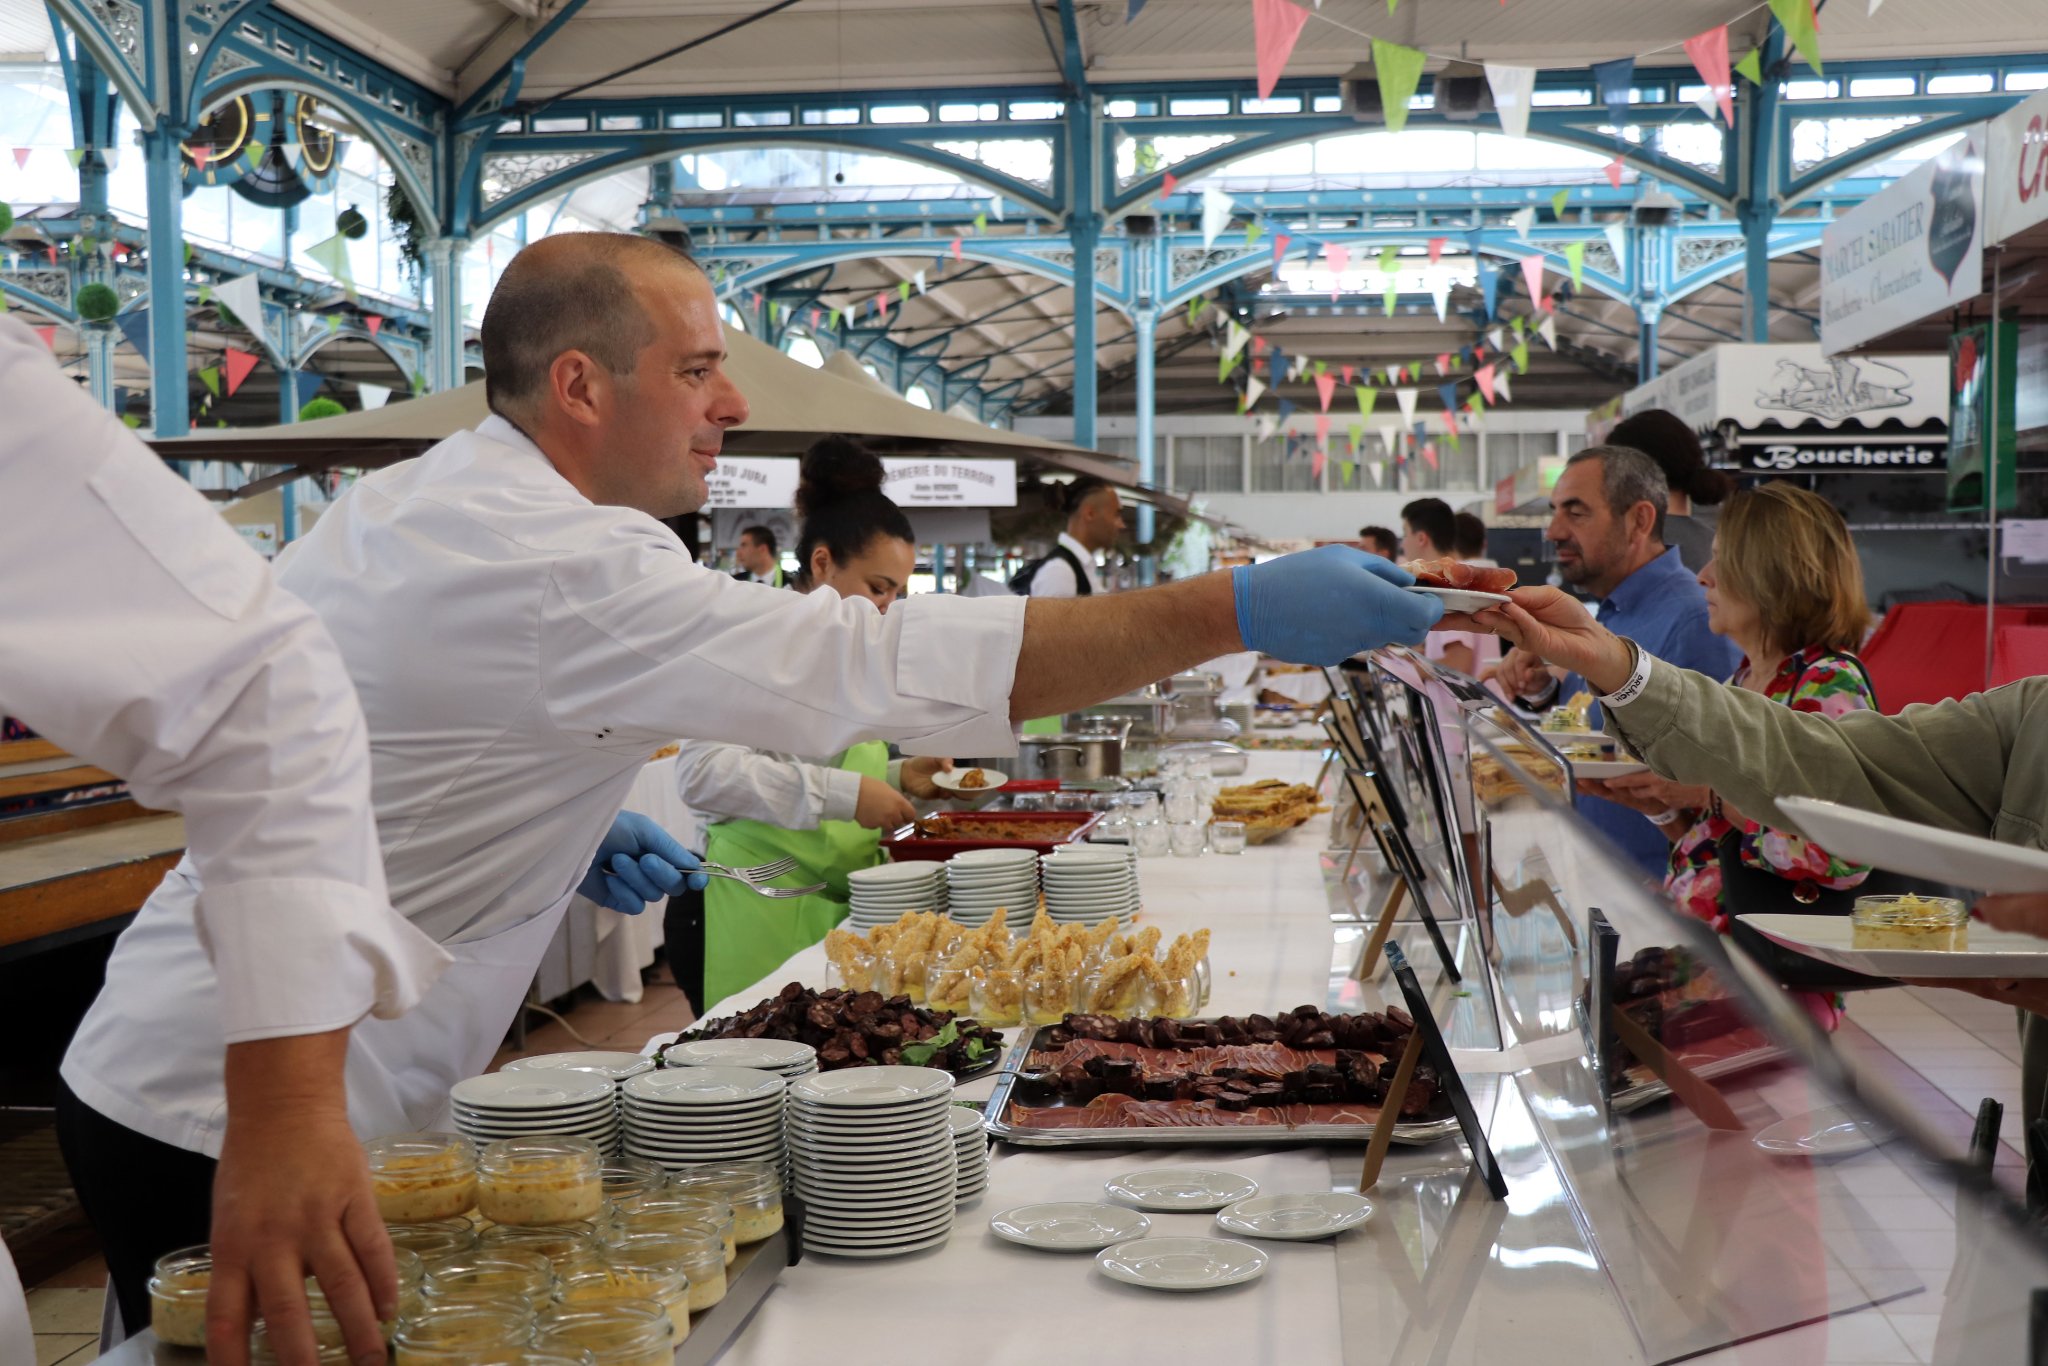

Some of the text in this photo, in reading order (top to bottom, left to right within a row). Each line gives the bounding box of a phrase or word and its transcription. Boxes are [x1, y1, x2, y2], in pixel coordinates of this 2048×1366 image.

[1867, 201, 1923, 262] SABATIER
[1753, 445, 1934, 469] Boucherie
[723, 465, 738, 477] DU
[740, 468, 768, 486] JURA
[934, 465, 948, 477] DU
[951, 466, 995, 488] TERROIR
[1615, 675, 1643, 701] BRUNCH
